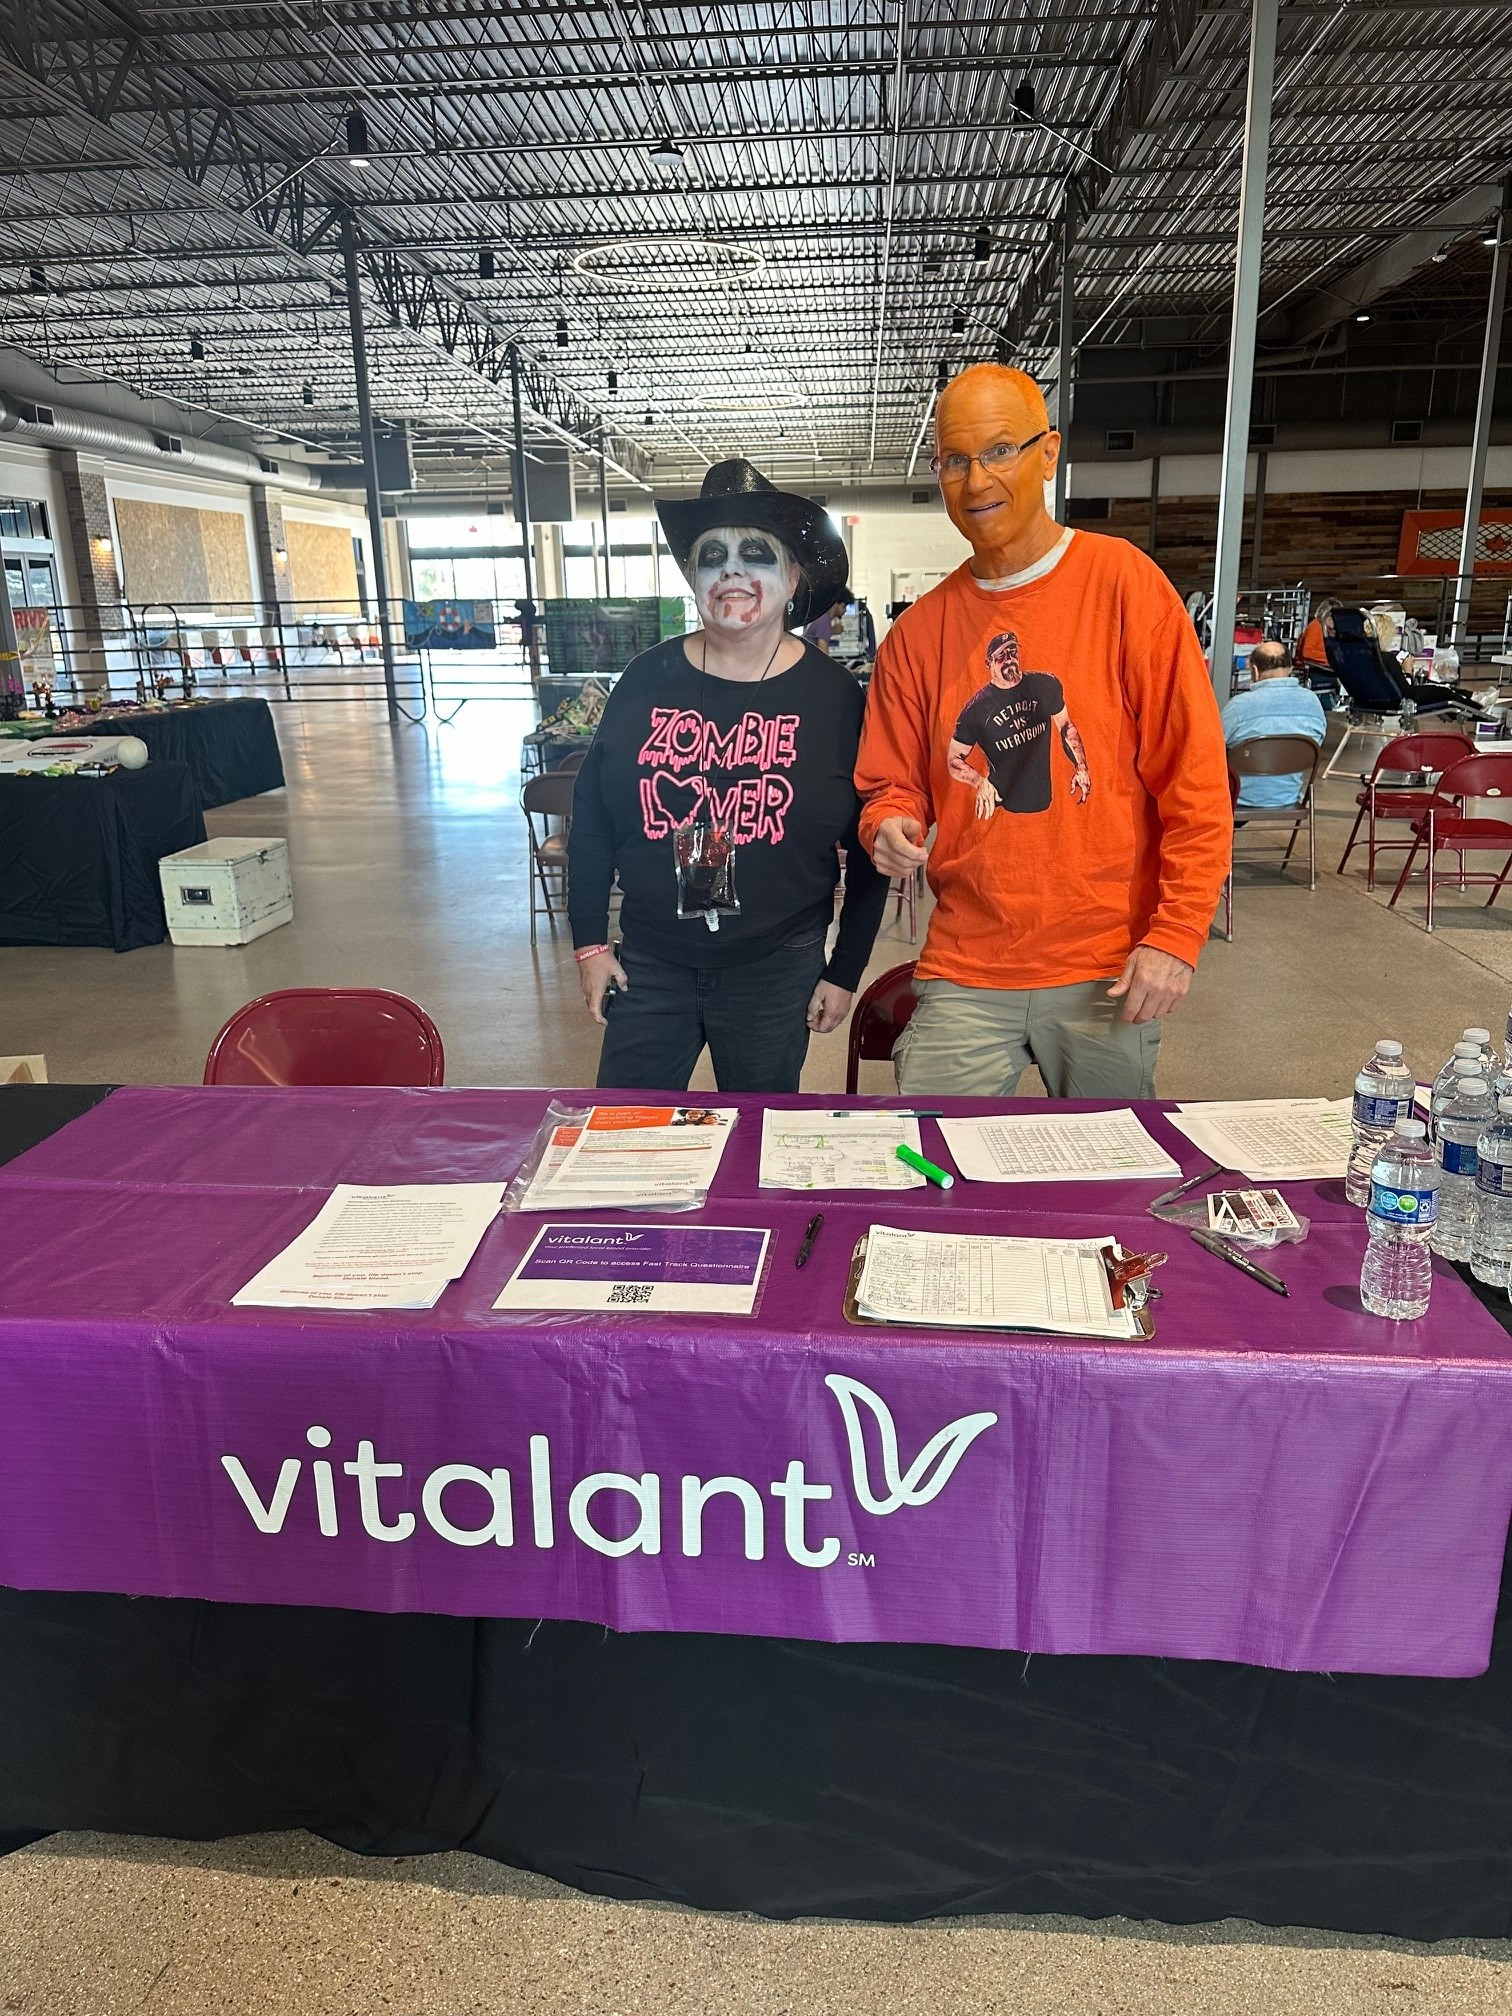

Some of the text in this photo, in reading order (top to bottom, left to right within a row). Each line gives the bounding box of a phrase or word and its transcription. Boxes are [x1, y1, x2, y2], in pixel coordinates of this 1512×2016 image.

[993, 700, 1038, 727] DETROIT
[637, 707, 801, 772] ZOMBIE
[995, 721, 1047, 751] EVERYBODY
[548, 1235, 624, 1245] vitalant
[875, 1230, 908, 1239] vitalant
[690, 1262, 750, 1270] Questionnaire
[221, 1425, 841, 1568] vitalant
[847, 1552, 876, 1568] SM
